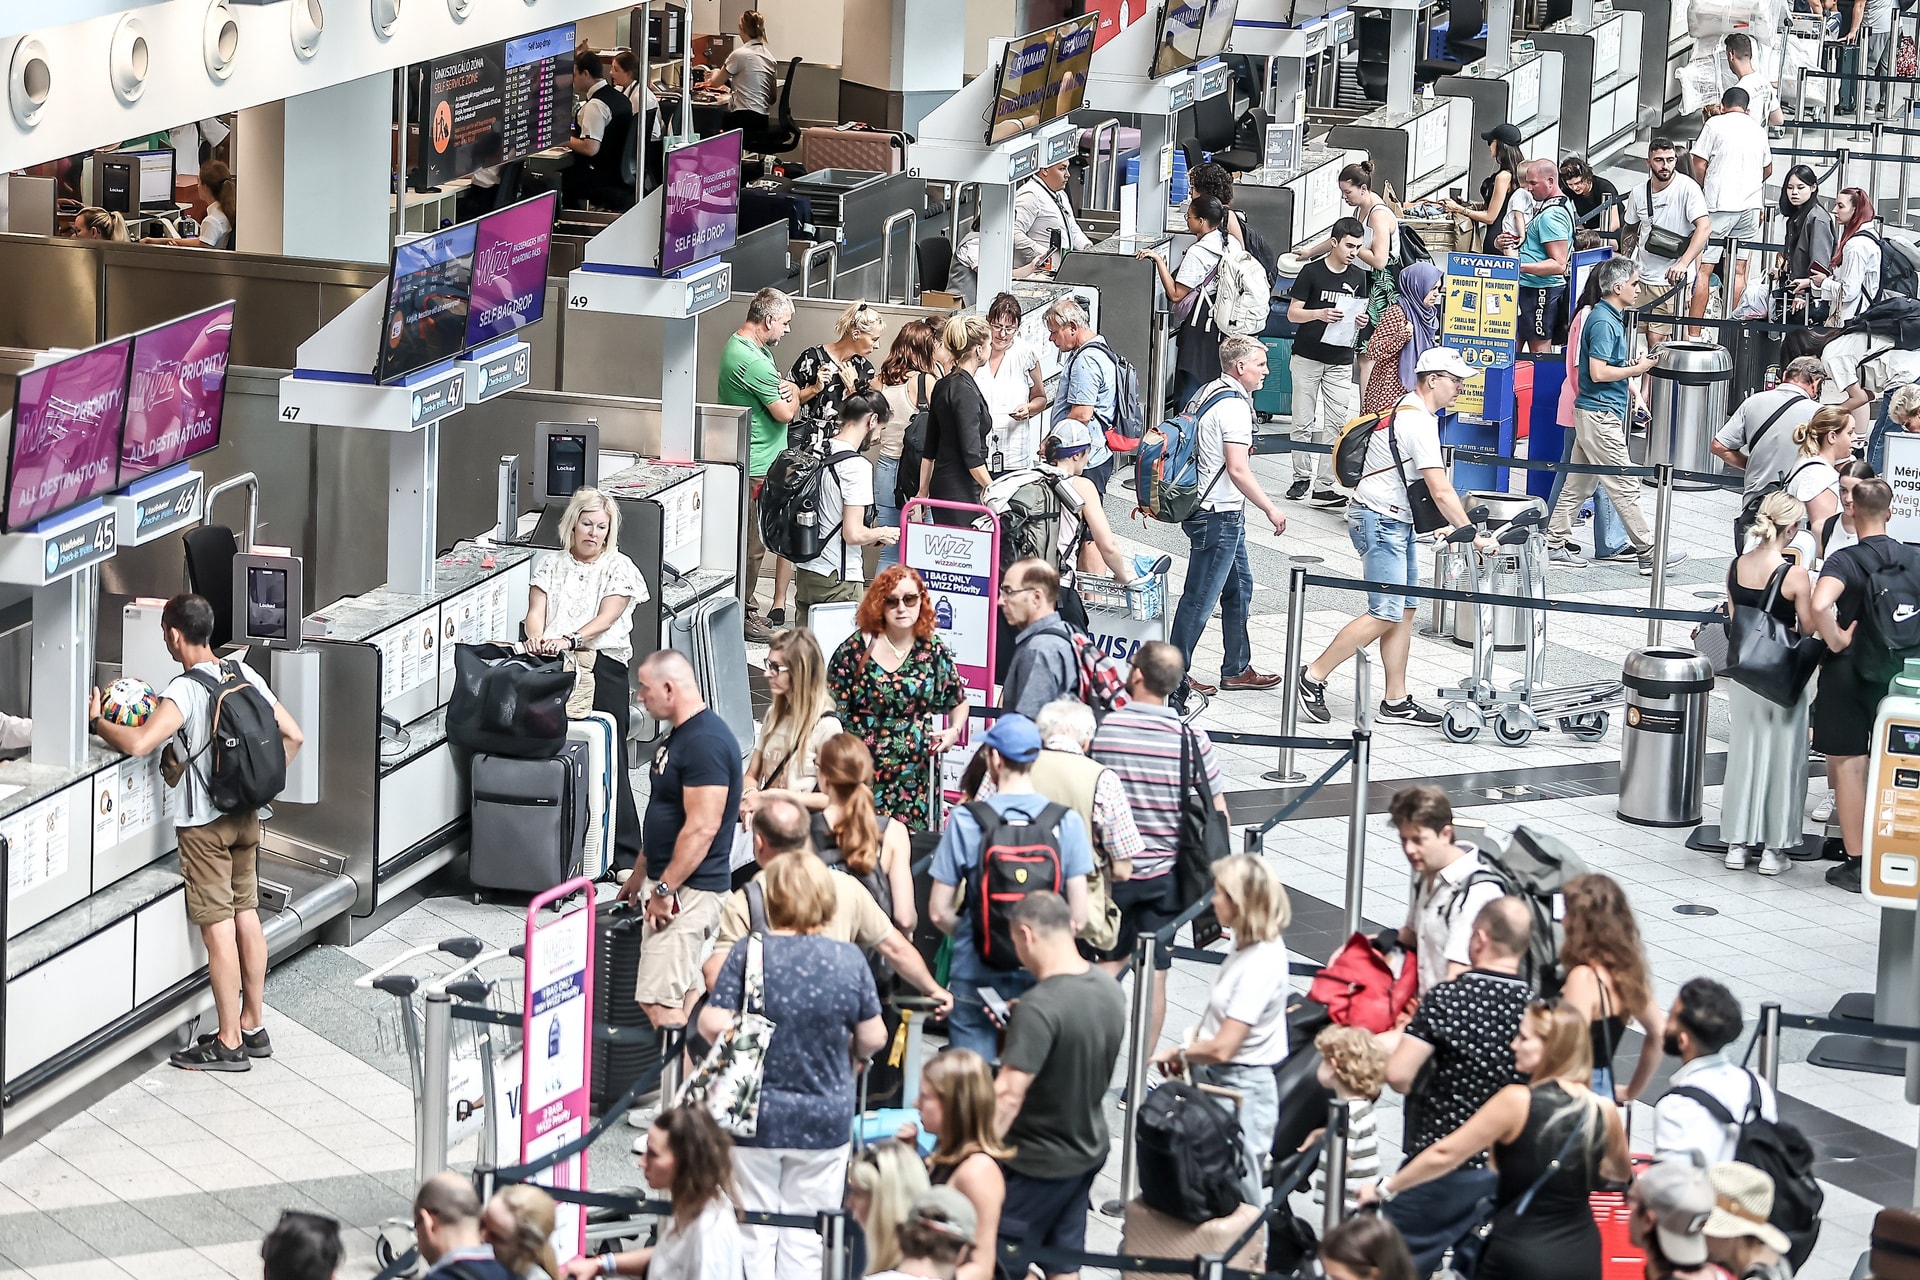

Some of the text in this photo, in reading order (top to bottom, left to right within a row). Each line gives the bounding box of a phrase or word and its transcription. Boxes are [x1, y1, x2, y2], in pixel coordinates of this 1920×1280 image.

[1015, 49, 1047, 72] RYANAIR
[434, 72, 479, 94] SELF SERVICE ZONE
[703, 167, 737, 184] PASSENGERS WITH
[909, 168, 920, 177] 61
[703, 180, 731, 197] BOARDING PASS
[513, 232, 548, 252] PASSENGERS WITH
[675, 223, 726, 253] SELF BAG DROP
[512, 248, 541, 266] BOARDING PASS
[1460, 257, 1514, 270] RYANAIR
[717, 272, 728, 293] 49
[1452, 279, 1478, 287] PRIORITY
[570, 295, 588, 308] 49
[479, 294, 533, 328] SELF BAG DROP
[1535, 289, 1546, 335] DEVERGO
[514, 353, 526, 376] 48
[447, 378, 462, 406] 47
[282, 406, 300, 420] 47
[130, 417, 212, 463] ALL DESTINATIONS
[18, 457, 109, 508] ALL DESTINATIONS
[174, 486, 195, 515] 46
[1892, 493, 1920, 507] Weig
[1891, 505, 1912, 519] bag
[93, 518, 114, 552] 45
[934, 560, 972, 569] wizzair.com
[930, 572, 947, 581] BAG
[948, 574, 971, 584] ONLY
[930, 581, 952, 590] WIZZ
[953, 583, 981, 595] Priority
[546, 981, 558, 999] BAG
[558, 975, 574, 992] ONLY
[546, 992, 561, 1009] WIZZ
[548, 1099, 563, 1117] BAGS
